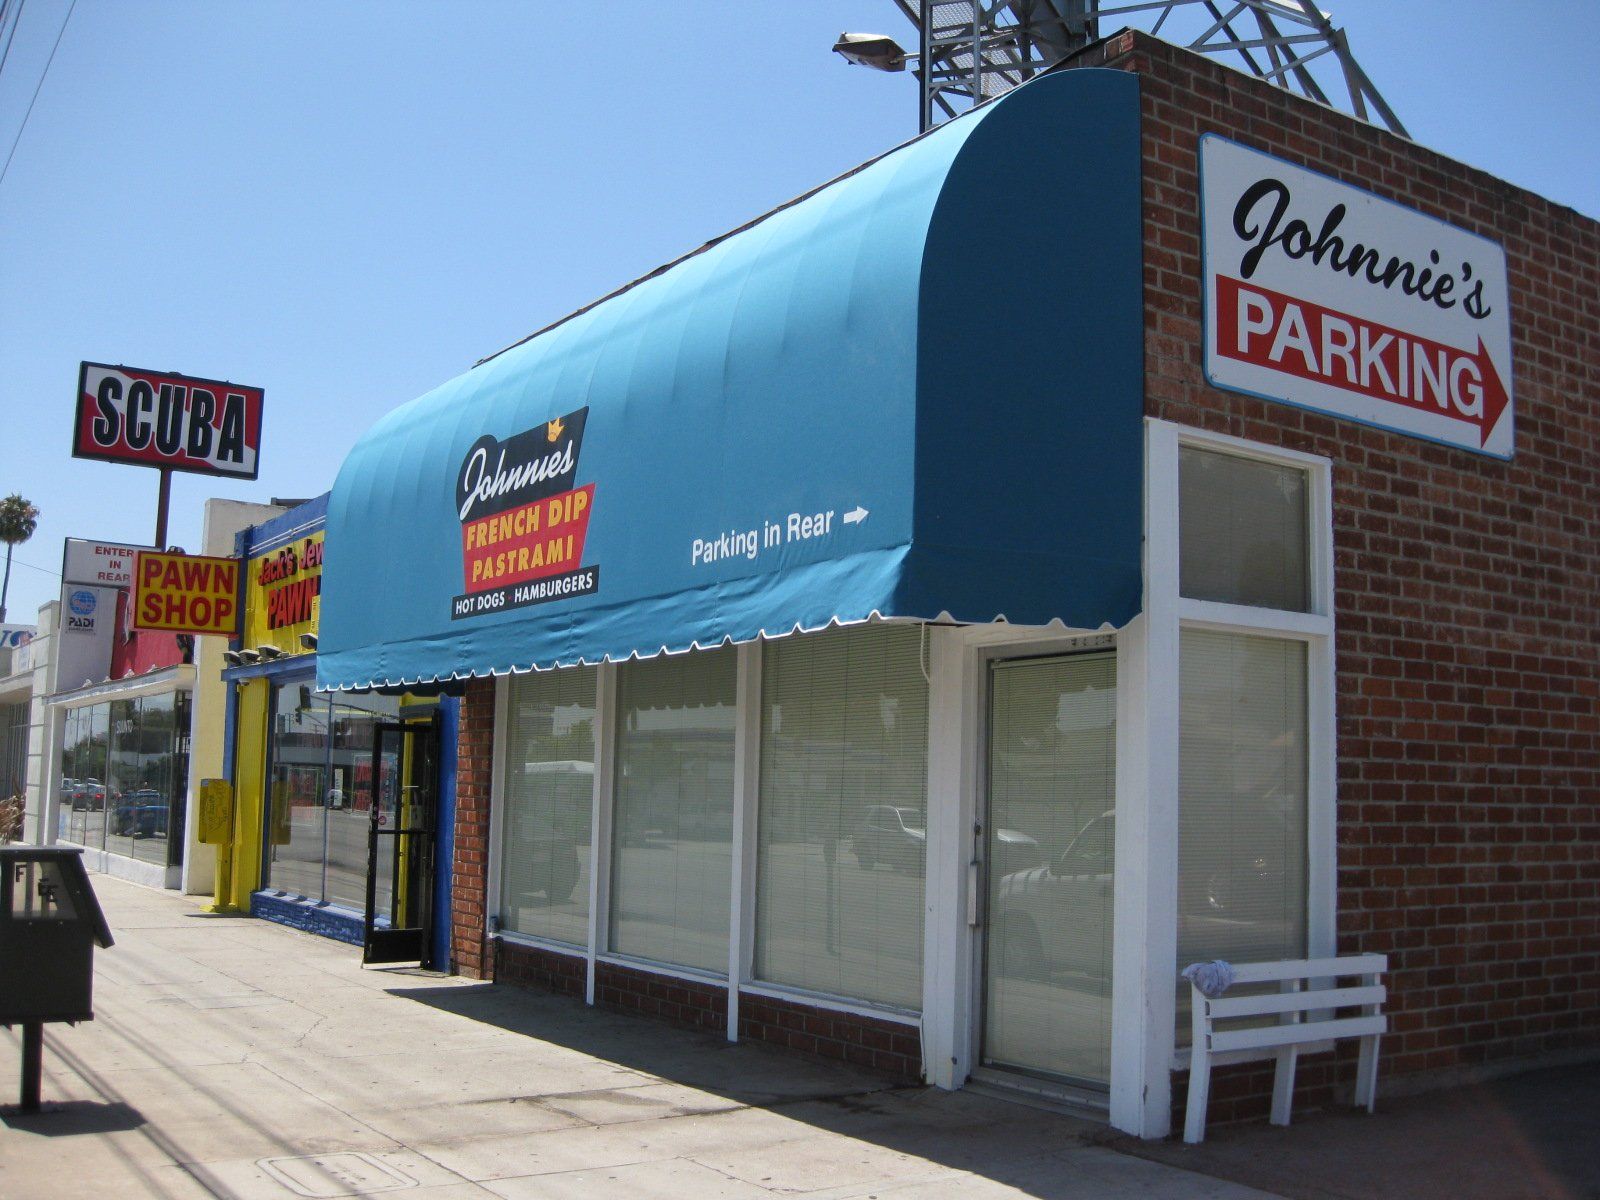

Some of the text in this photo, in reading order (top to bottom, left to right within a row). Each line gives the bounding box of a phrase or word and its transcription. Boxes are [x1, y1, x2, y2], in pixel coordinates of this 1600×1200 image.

[1233, 178, 1491, 319] Johnnie's
[1237, 287, 1484, 419] PARKING
[92, 376, 247, 464] SCUBA
[466, 490, 588, 551] FRENCH DIP
[692, 510, 835, 566] Parking in Rear
[95, 546, 134, 557] ENTER
[109, 560, 122, 569] IN
[258, 548, 297, 586] Jack's
[472, 534, 574, 583] PASTRAMI
[143, 558, 235, 594] PAWN
[455, 572, 593, 615] HOT DOGS HAMBURGERS
[69, 617, 95, 628] PADI
[142, 592, 232, 627] SHOP
[267, 576, 320, 630] PAWN
